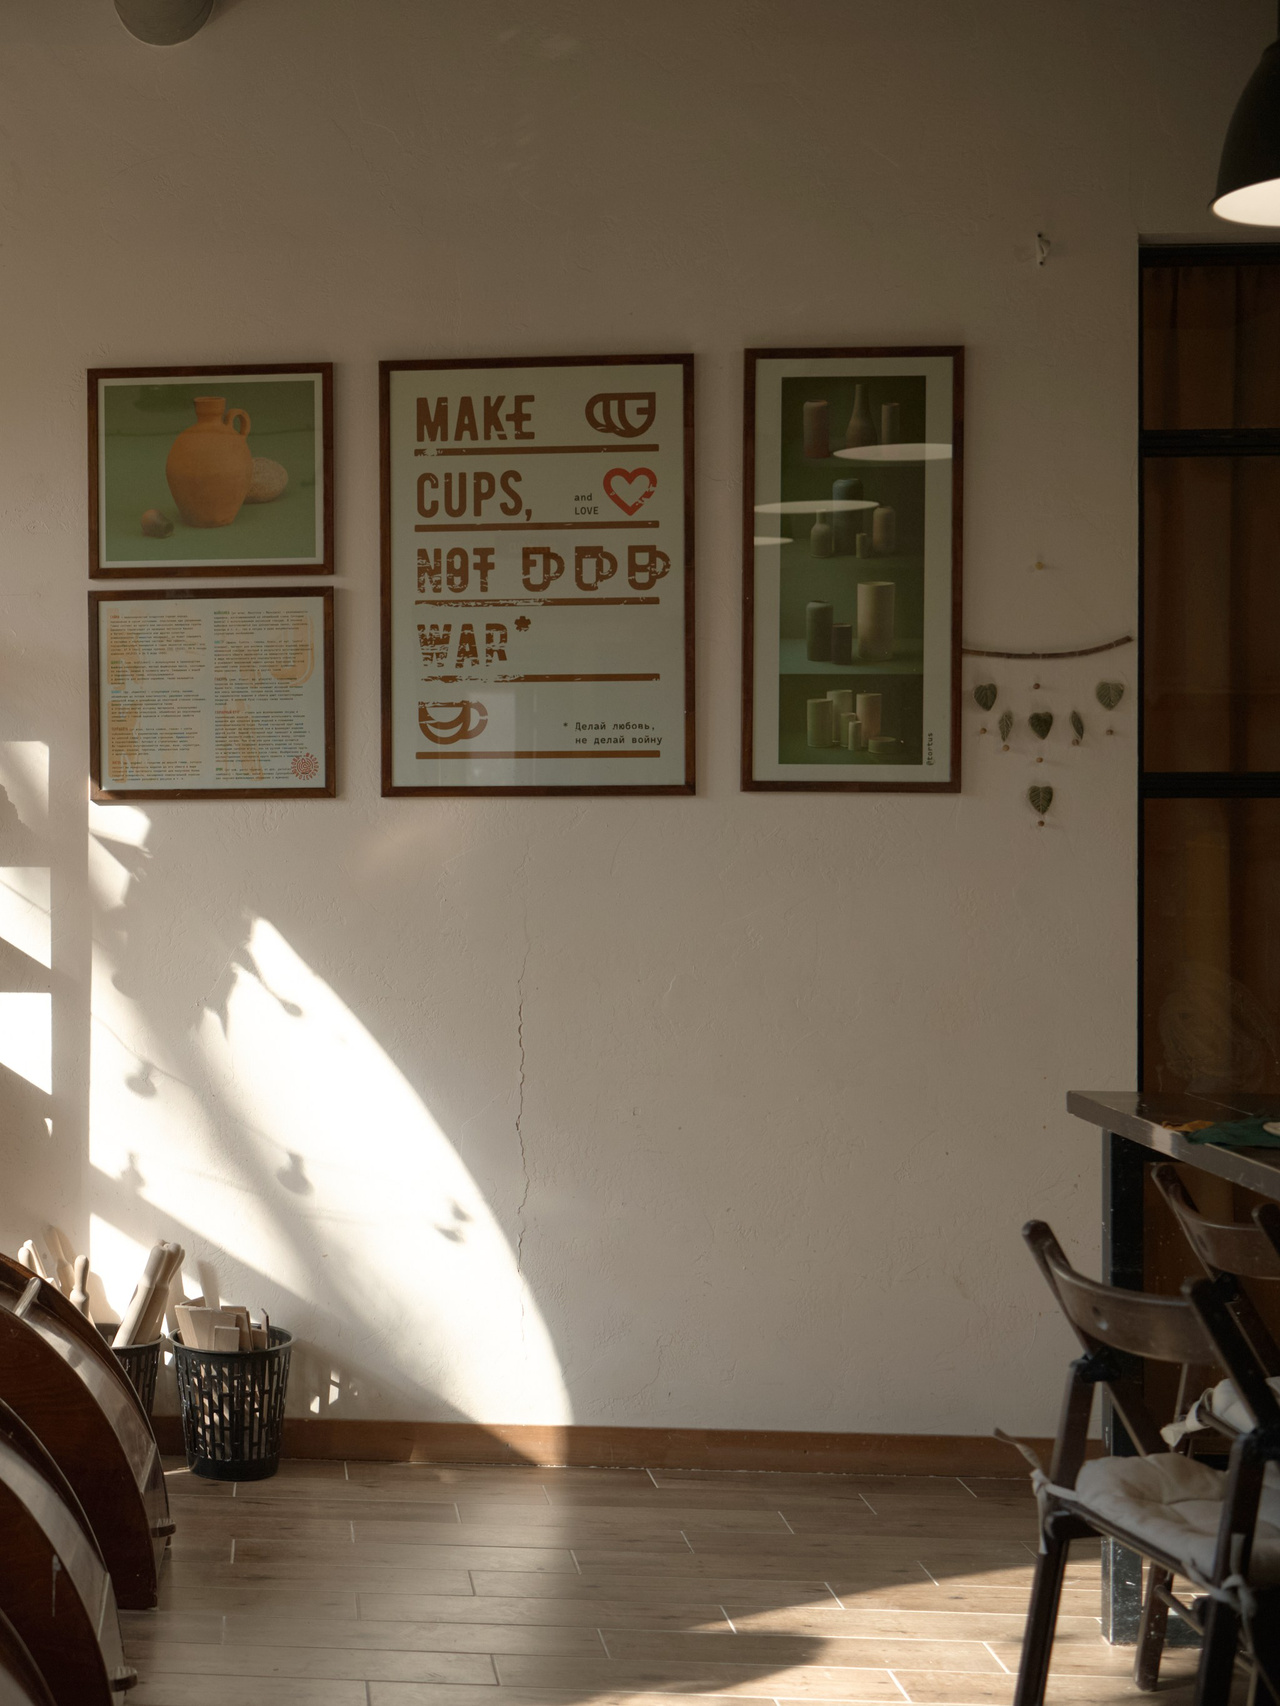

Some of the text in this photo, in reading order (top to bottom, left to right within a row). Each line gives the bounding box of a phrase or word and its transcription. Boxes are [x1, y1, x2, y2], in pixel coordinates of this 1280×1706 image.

[416, 394, 535, 442] MAKE
[416, 469, 533, 522] CUPS,
[574, 493, 593, 501] and
[574, 506, 599, 515] LOVE
[416, 546, 495, 593] NOT
[575, 722, 655, 732] Делай любовь,
[593, 736, 625, 745] делай
[631, 736, 662, 745] войну
[926, 732, 934, 766] @tortus
